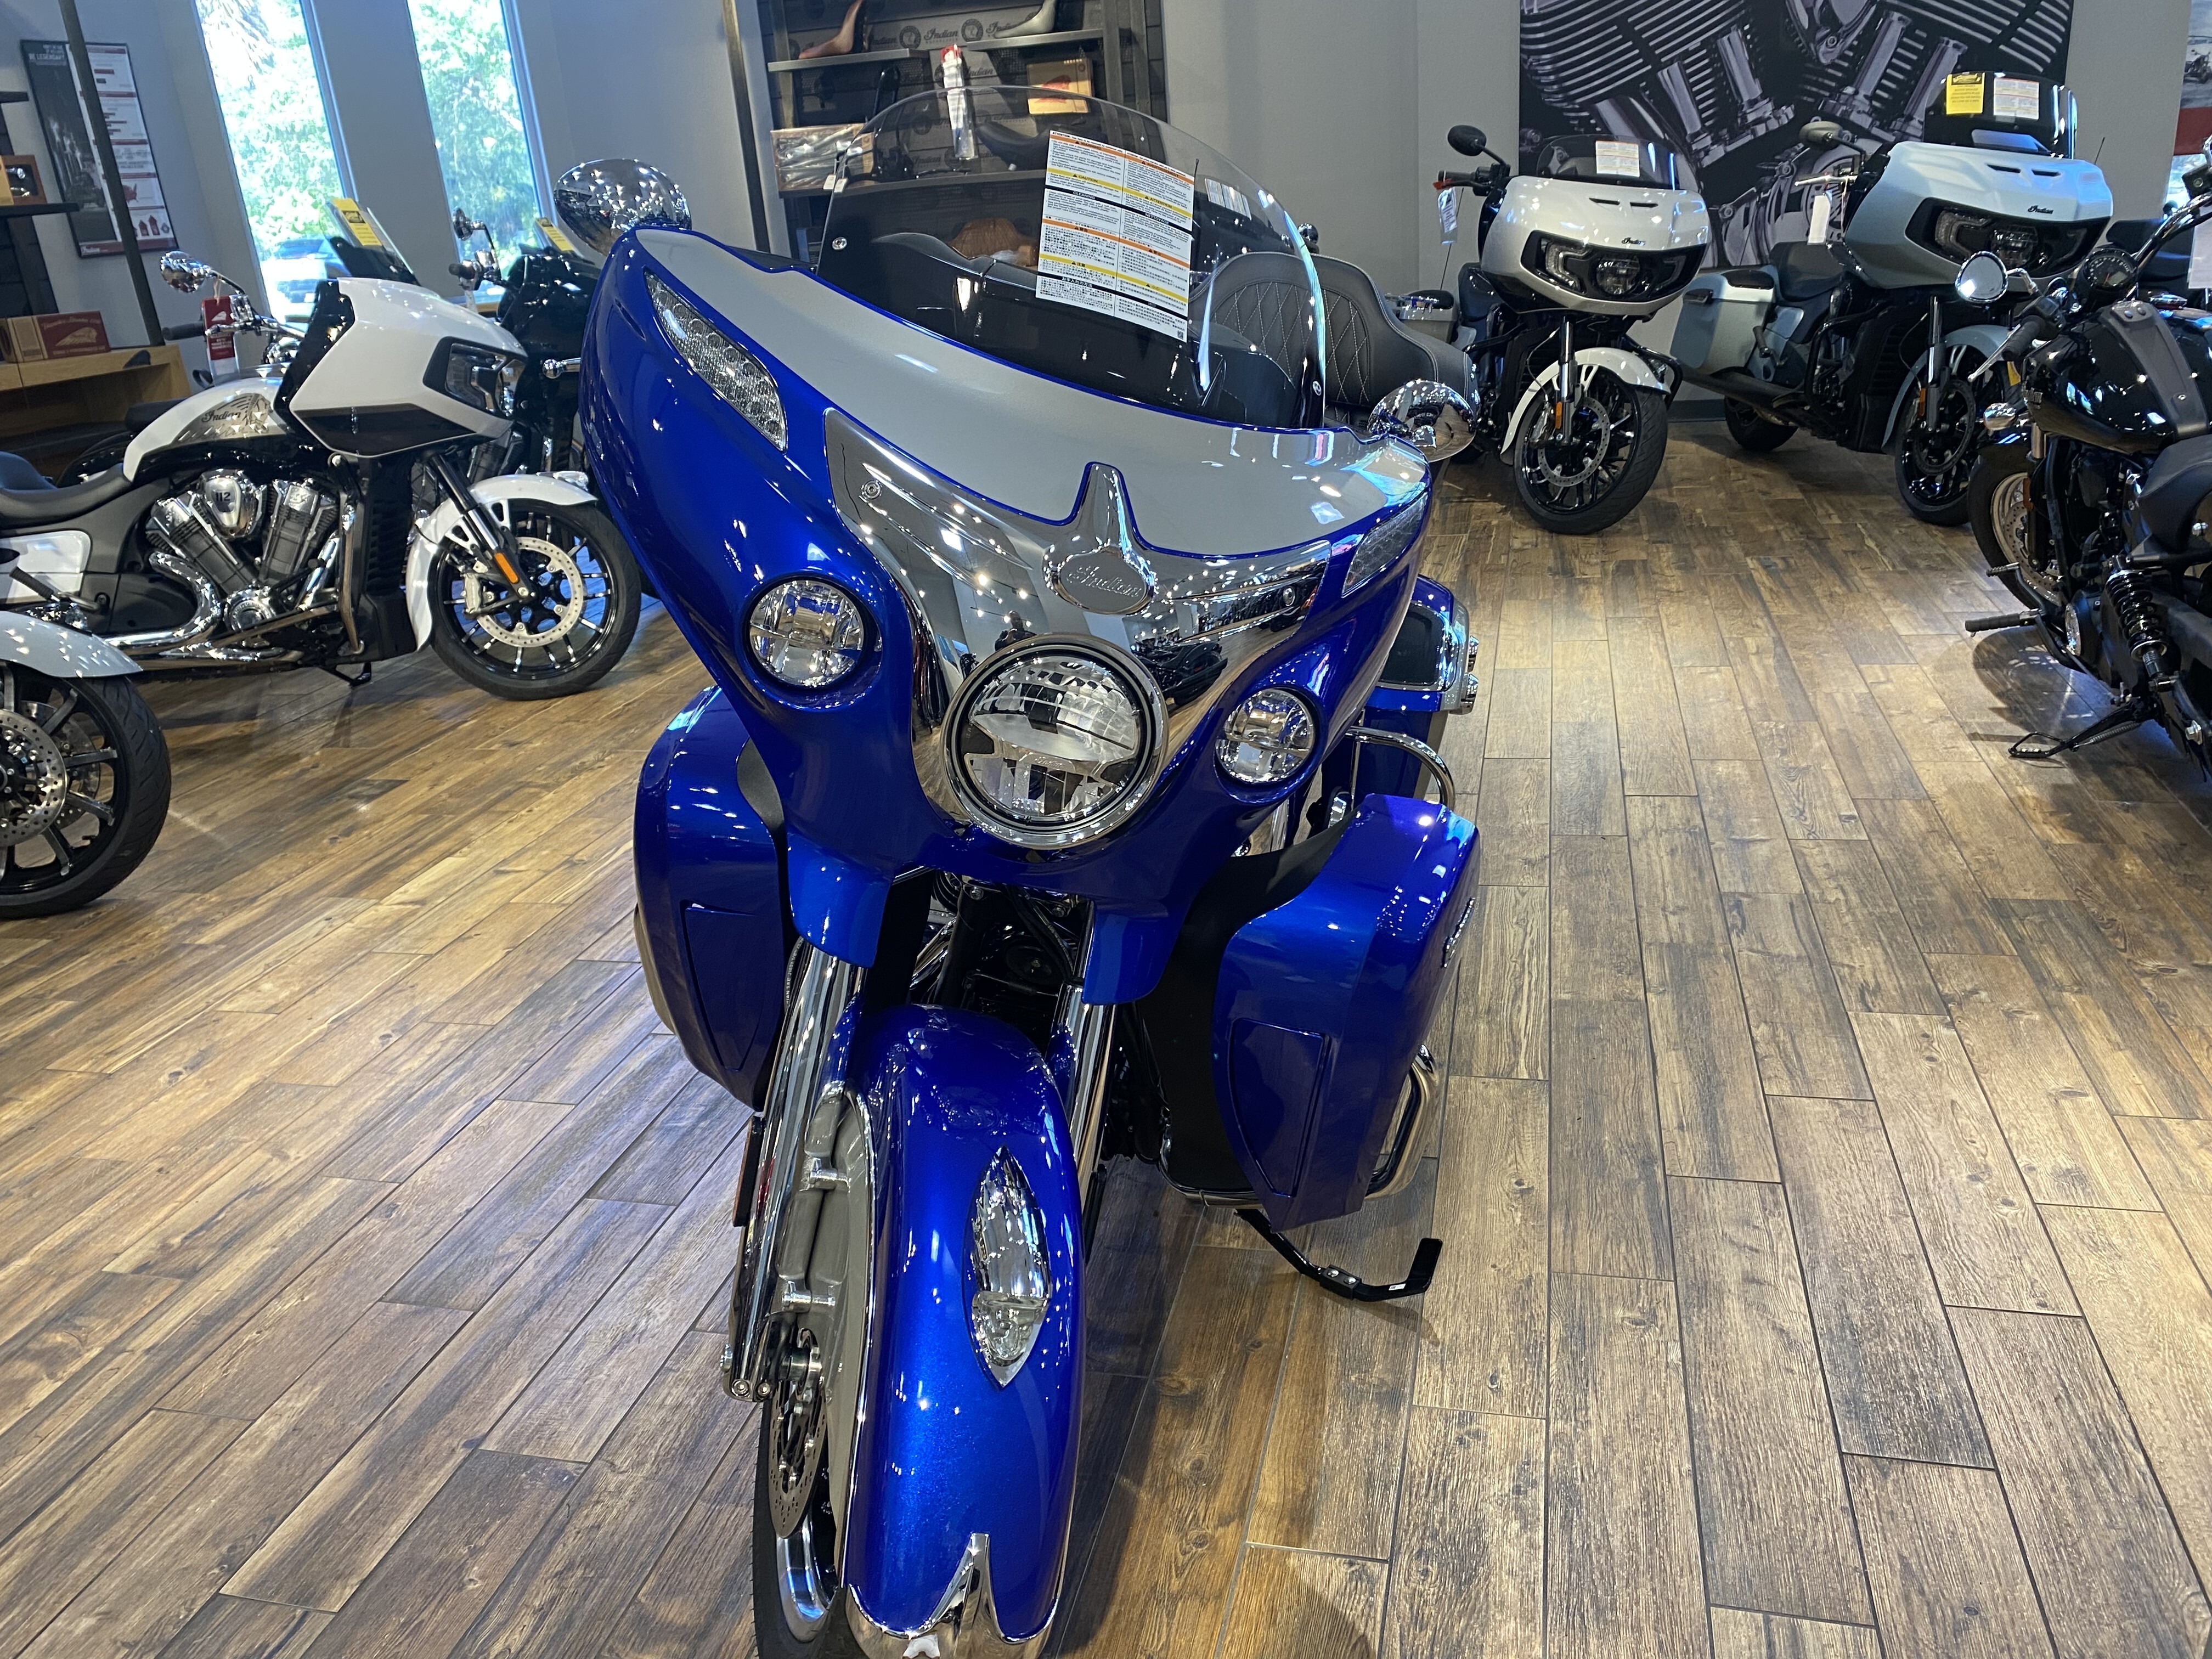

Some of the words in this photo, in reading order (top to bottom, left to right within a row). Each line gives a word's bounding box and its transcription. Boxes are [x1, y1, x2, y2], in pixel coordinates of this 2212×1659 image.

[924, 28, 958, 40] Indian
[1073, 191, 1095, 200] CLEANING
[1150, 198, 1172, 209] ATTENTION
[1062, 277, 1092, 287] お手入れの方法
[201, 409, 241, 422] Indian
[216, 492, 230, 501] 112
[1066, 566, 1142, 597] Indian
